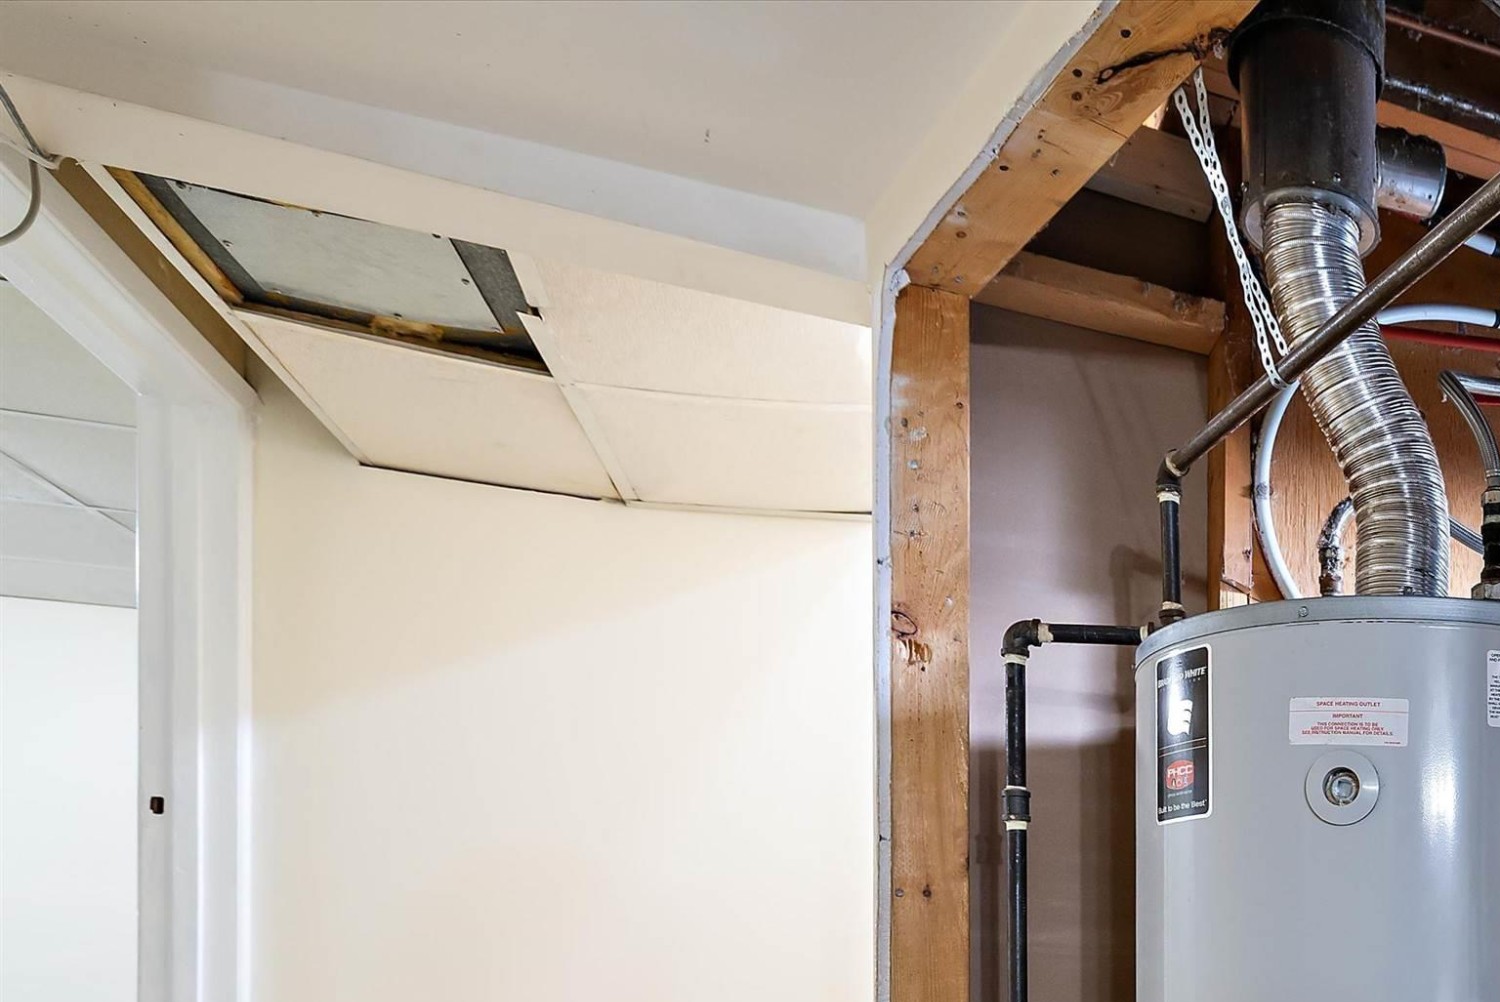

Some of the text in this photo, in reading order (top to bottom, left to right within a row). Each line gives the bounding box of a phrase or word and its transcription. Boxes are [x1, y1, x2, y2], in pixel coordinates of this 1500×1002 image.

[1184, 666, 1207, 680] WHITE
[1167, 764, 1194, 779] PHCC
[1173, 803, 1180, 811] be
[1180, 801, 1190, 810] the
